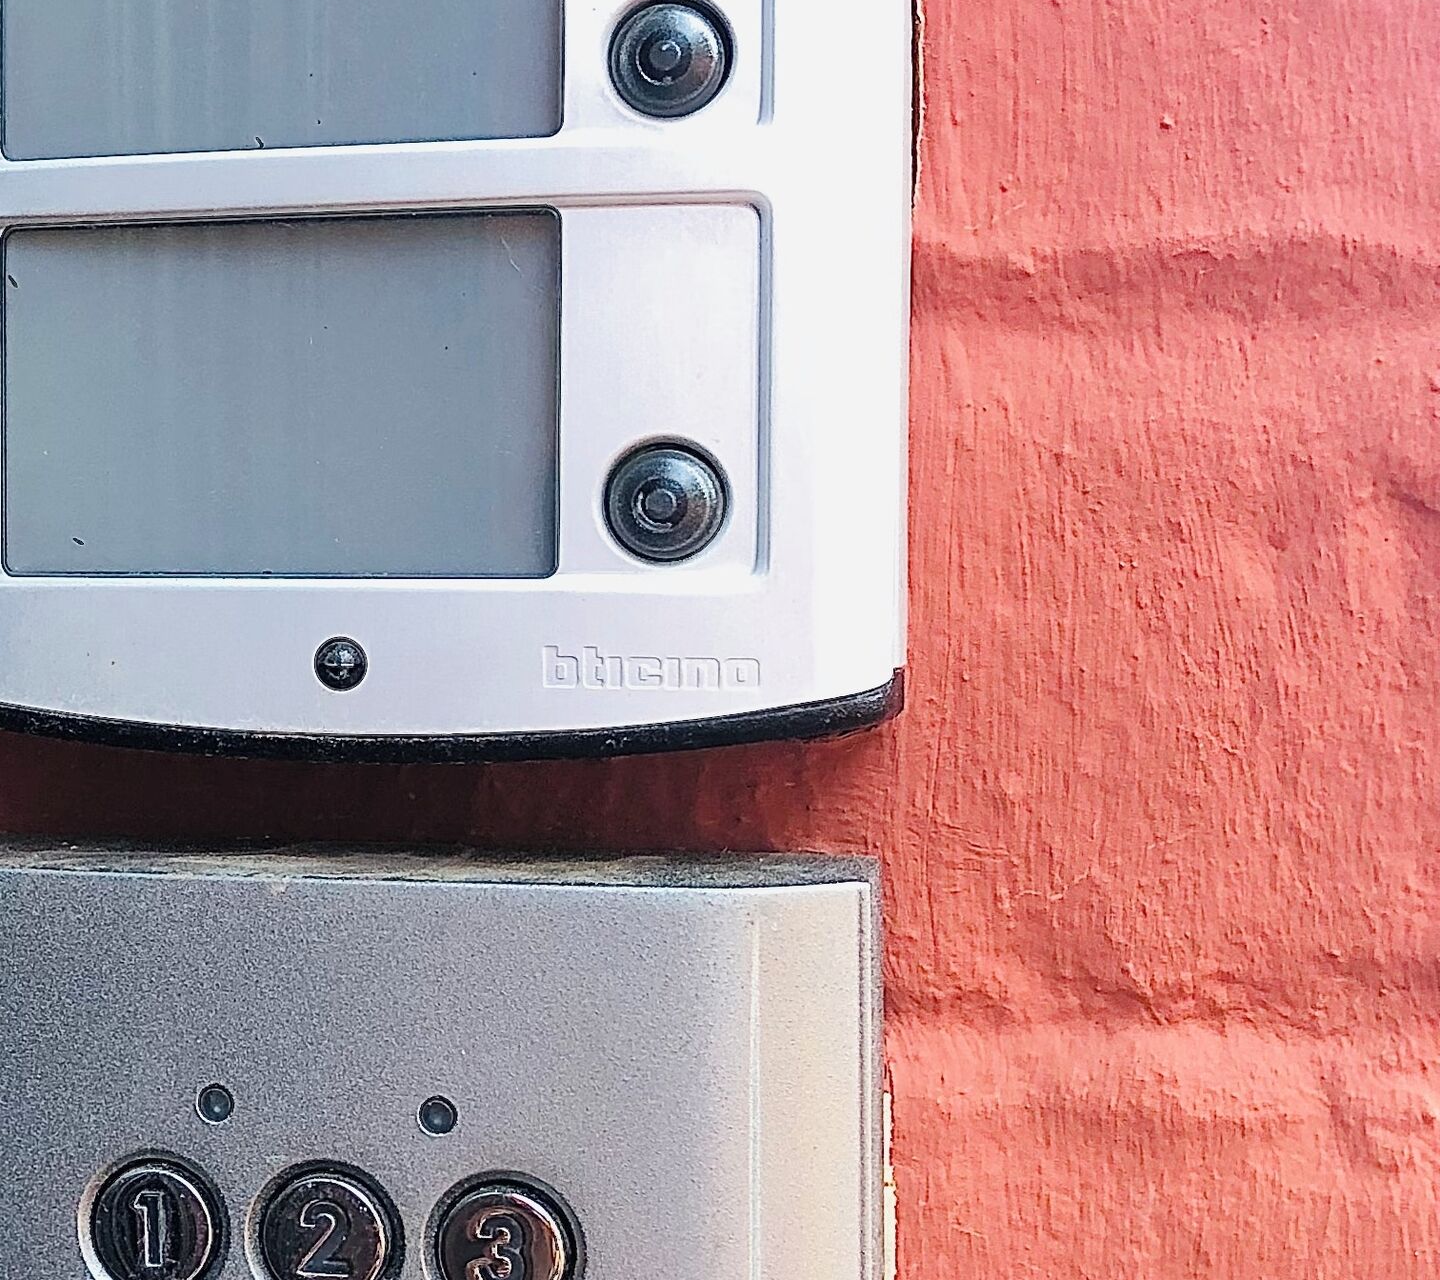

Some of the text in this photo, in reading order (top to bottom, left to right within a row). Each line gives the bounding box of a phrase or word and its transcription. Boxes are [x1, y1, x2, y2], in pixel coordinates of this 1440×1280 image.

[542, 644, 760, 690] bticino
[133, 1190, 164, 1268] 1
[296, 1199, 351, 1278] 2
